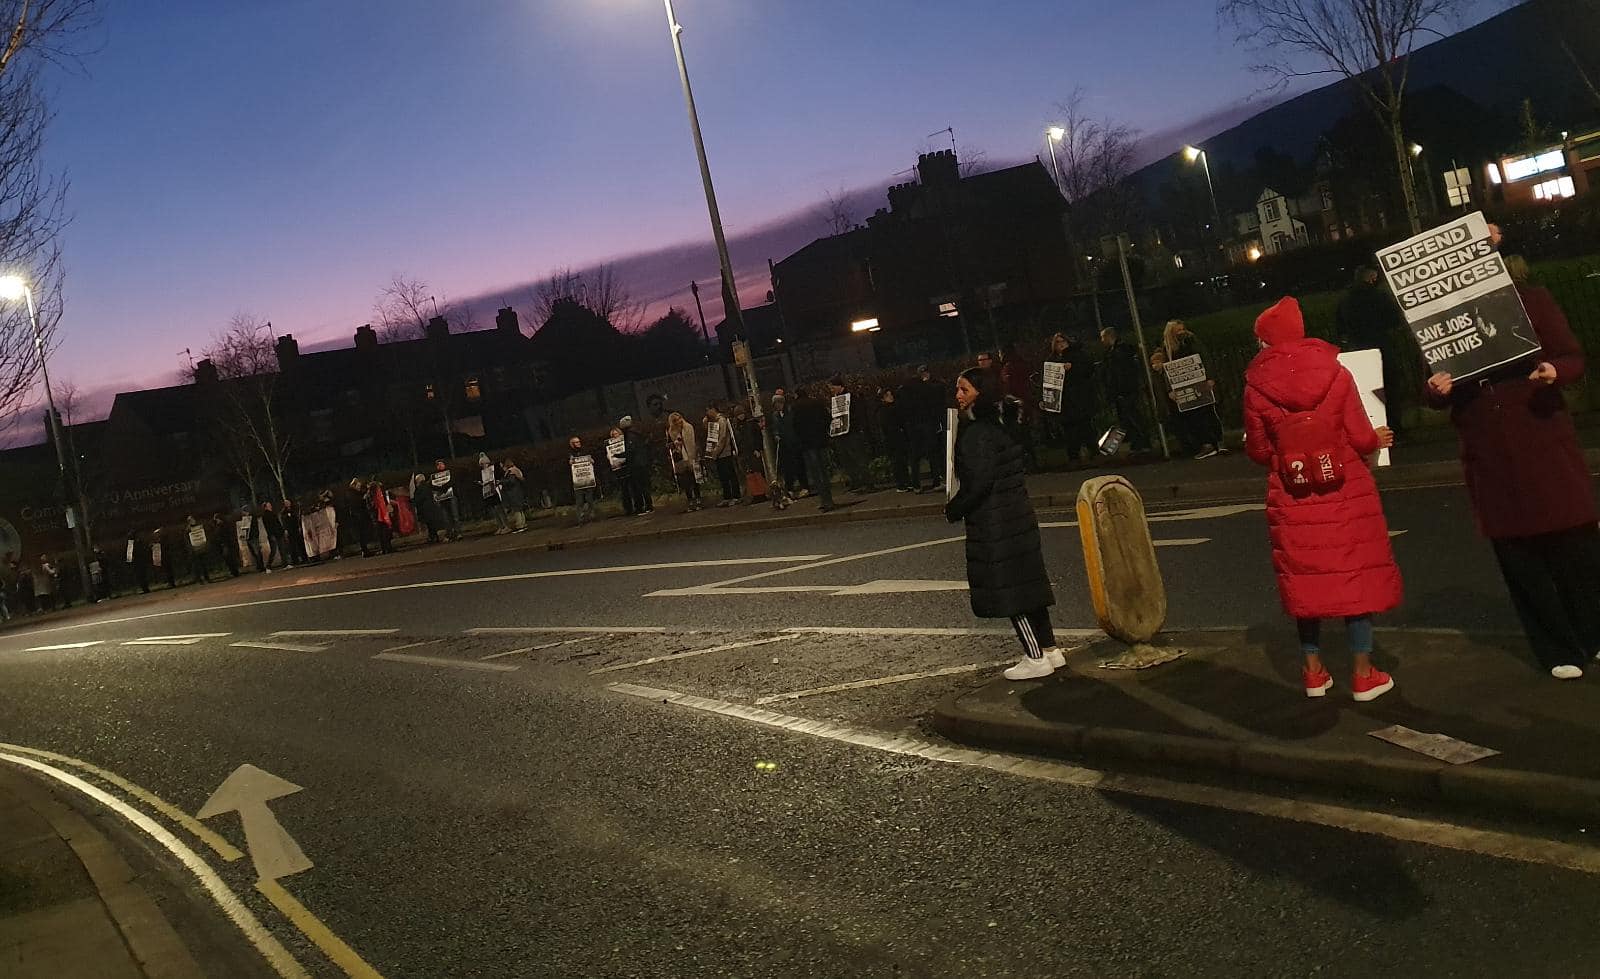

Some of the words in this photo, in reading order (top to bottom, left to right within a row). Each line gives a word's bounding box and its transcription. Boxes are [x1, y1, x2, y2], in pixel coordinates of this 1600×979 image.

[1385, 227, 1466, 268] DEFEND
[1393, 241, 1491, 287] WOMEN'S
[1403, 260, 1498, 307] SERVICES
[1416, 322, 1445, 344] SAVE
[1446, 312, 1473, 333] JOBS
[1424, 342, 1455, 365] SAVE
[1452, 332, 1482, 355] LIVES
[123, 480, 201, 502] Anniversary
